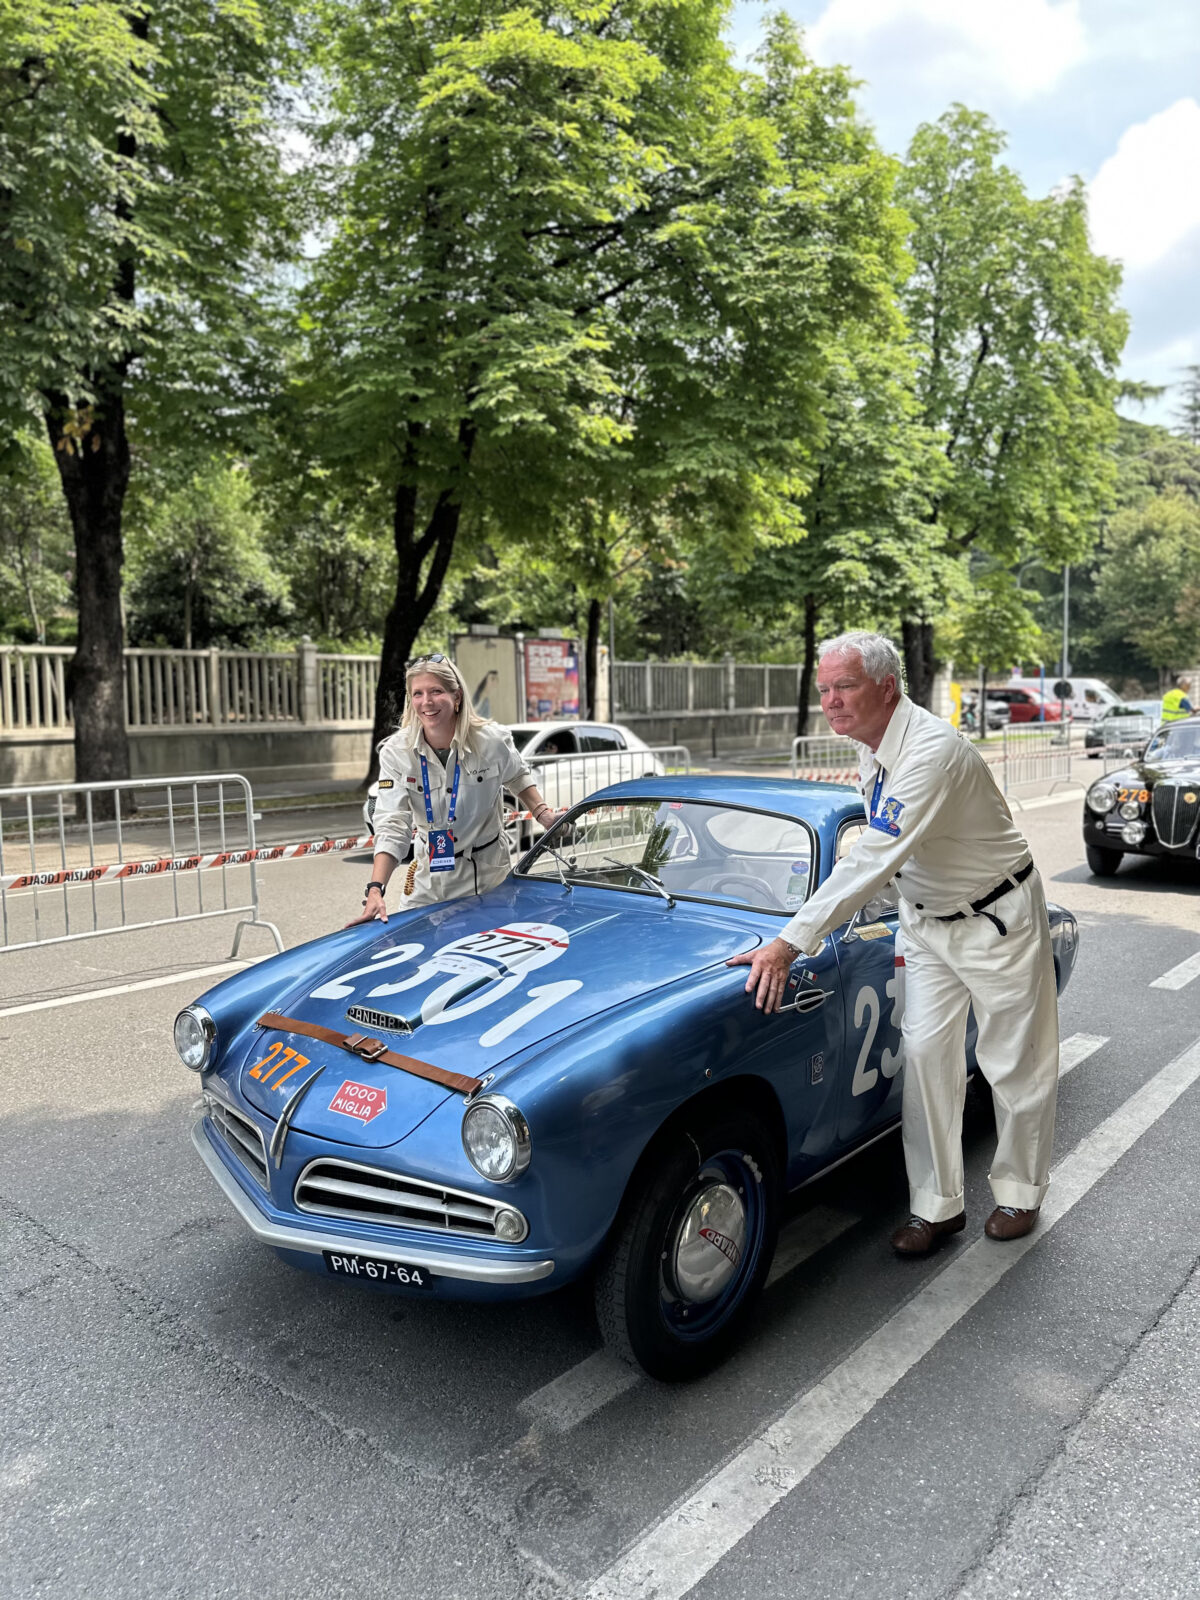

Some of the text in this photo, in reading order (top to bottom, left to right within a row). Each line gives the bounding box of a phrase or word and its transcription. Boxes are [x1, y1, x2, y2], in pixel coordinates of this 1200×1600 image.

[1118, 789, 1148, 803] 278
[454, 933, 546, 958] 277
[249, 1042, 311, 1091] 277
[345, 1085, 377, 1102] 1000
[333, 1097, 371, 1118] MIGLIA
[331, 1255, 424, 1286] PM-67-64
